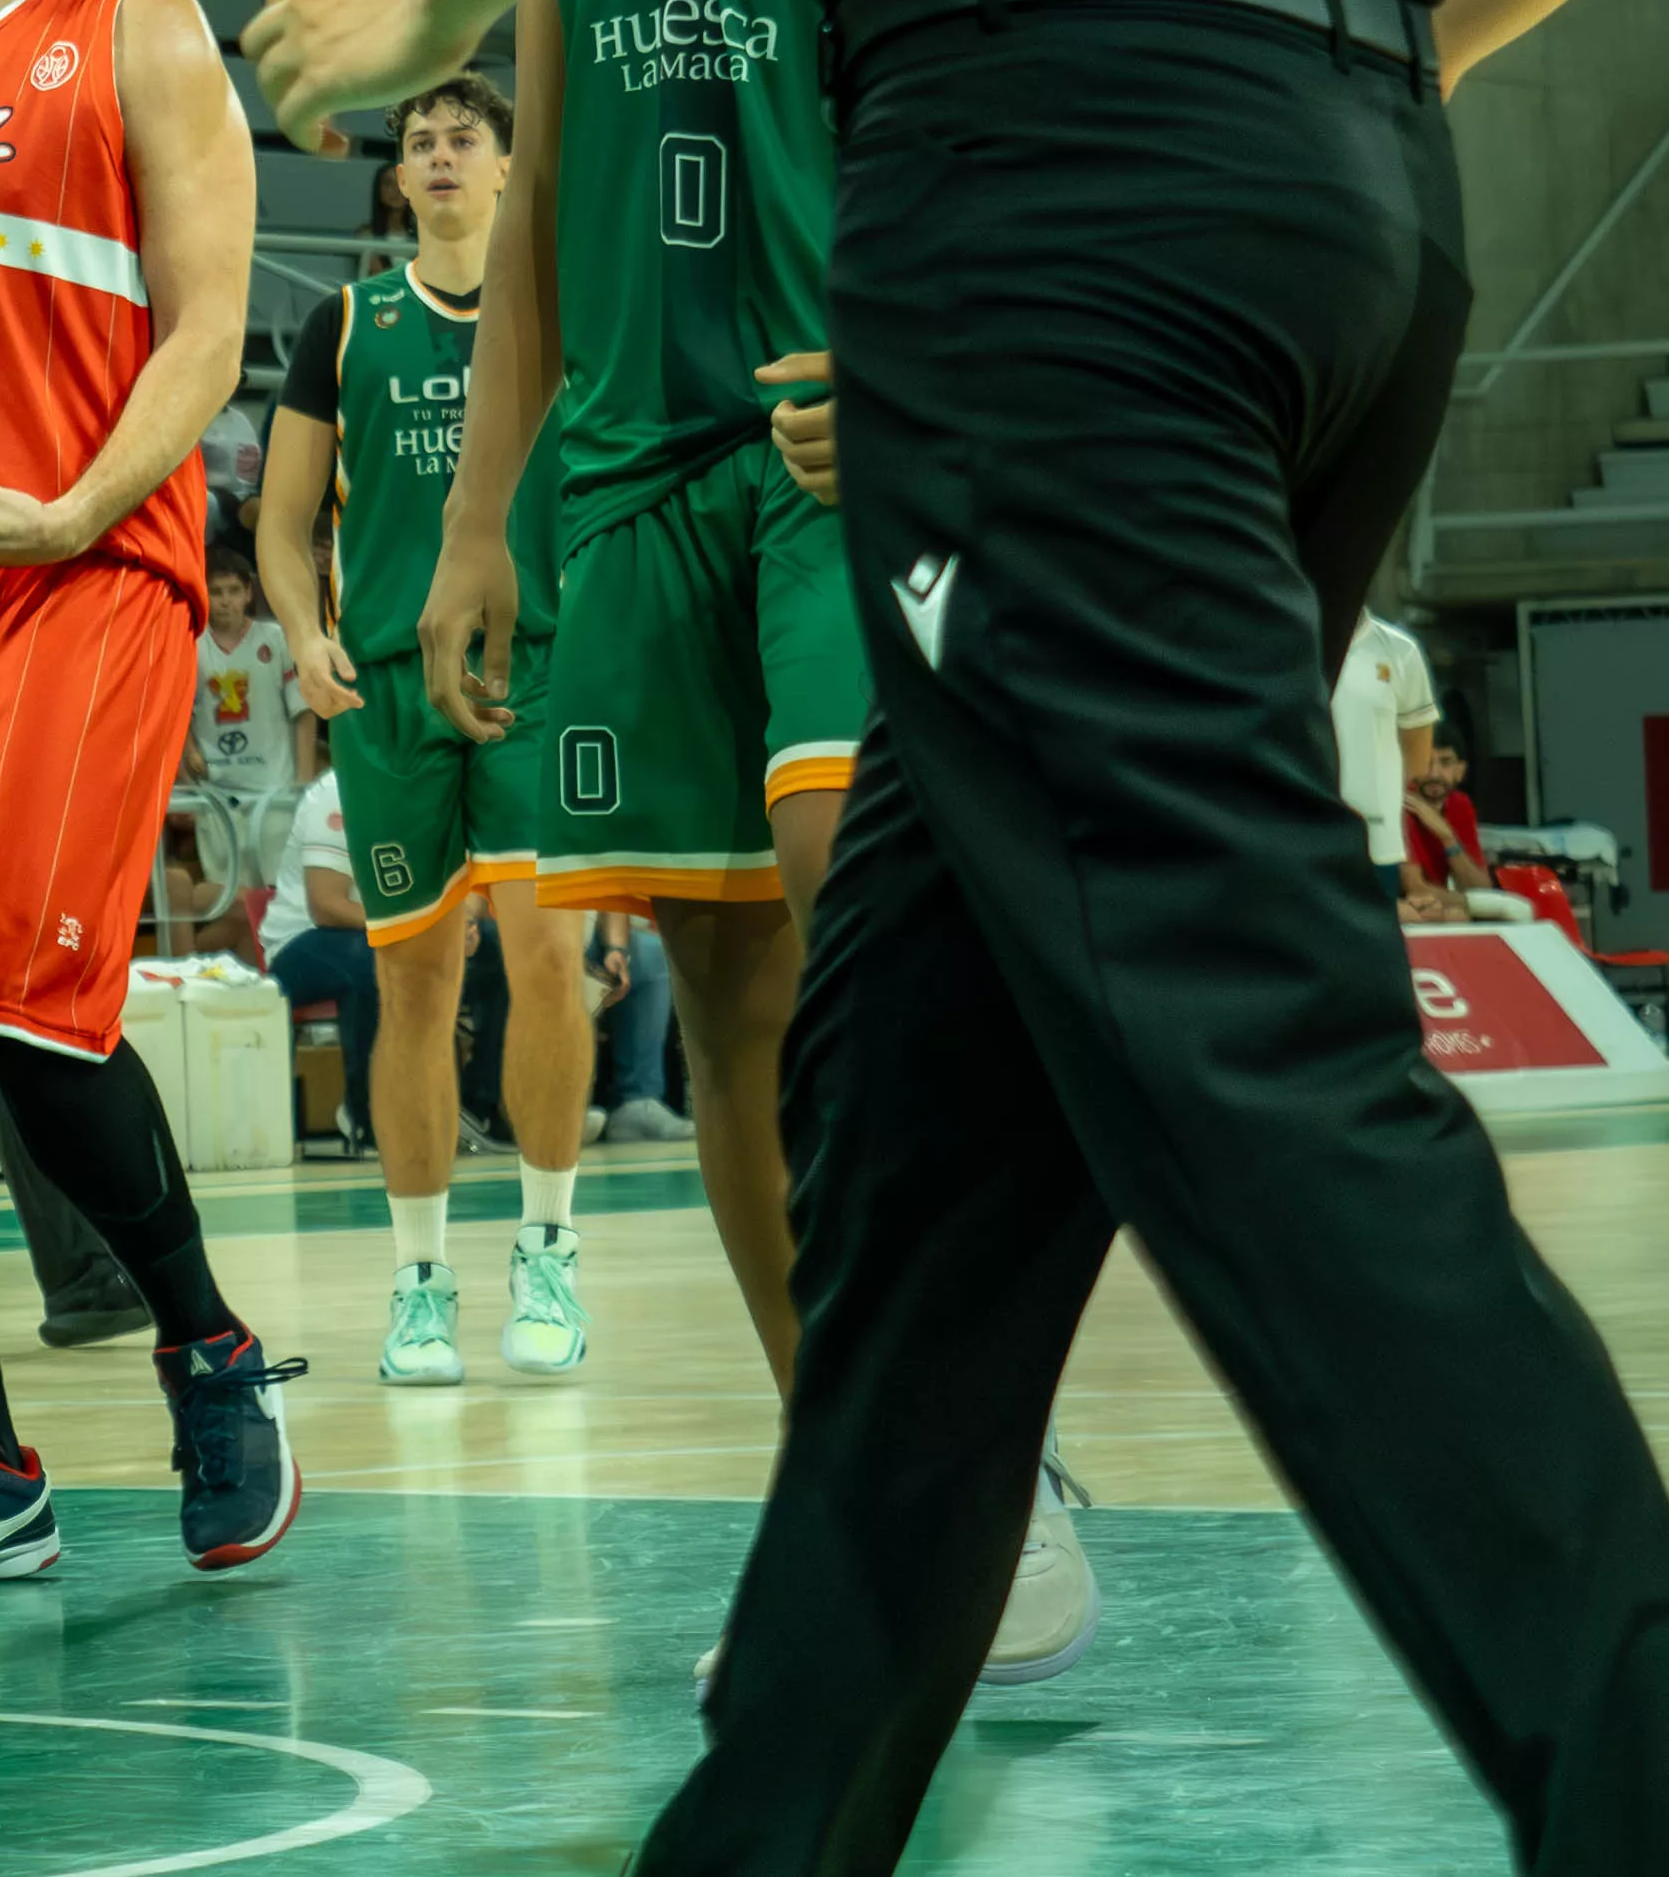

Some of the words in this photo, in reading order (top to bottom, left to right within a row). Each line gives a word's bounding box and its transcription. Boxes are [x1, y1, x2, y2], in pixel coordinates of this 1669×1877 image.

[659, 132, 727, 249] 0
[559, 724, 621, 816] 0
[370, 842, 415, 898] 6
